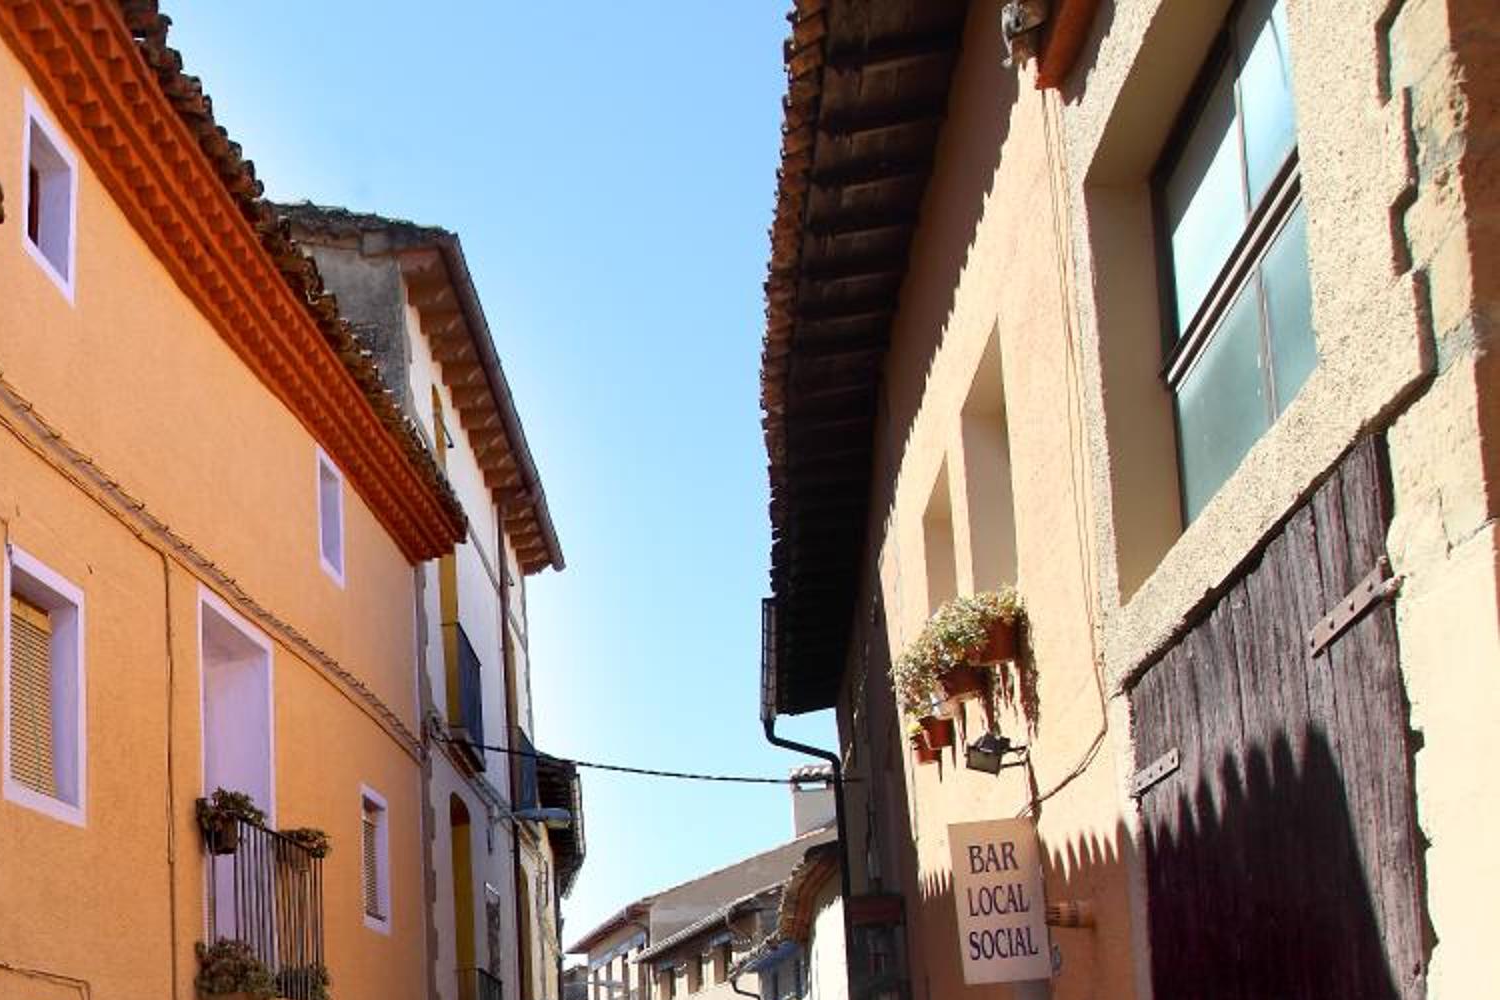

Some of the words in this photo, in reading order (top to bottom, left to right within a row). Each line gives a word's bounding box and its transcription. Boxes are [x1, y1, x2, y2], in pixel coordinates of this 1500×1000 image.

[968, 842, 1018, 874] BAR
[968, 884, 1030, 917] LOCAL
[968, 926, 1039, 961] SOCIAL
